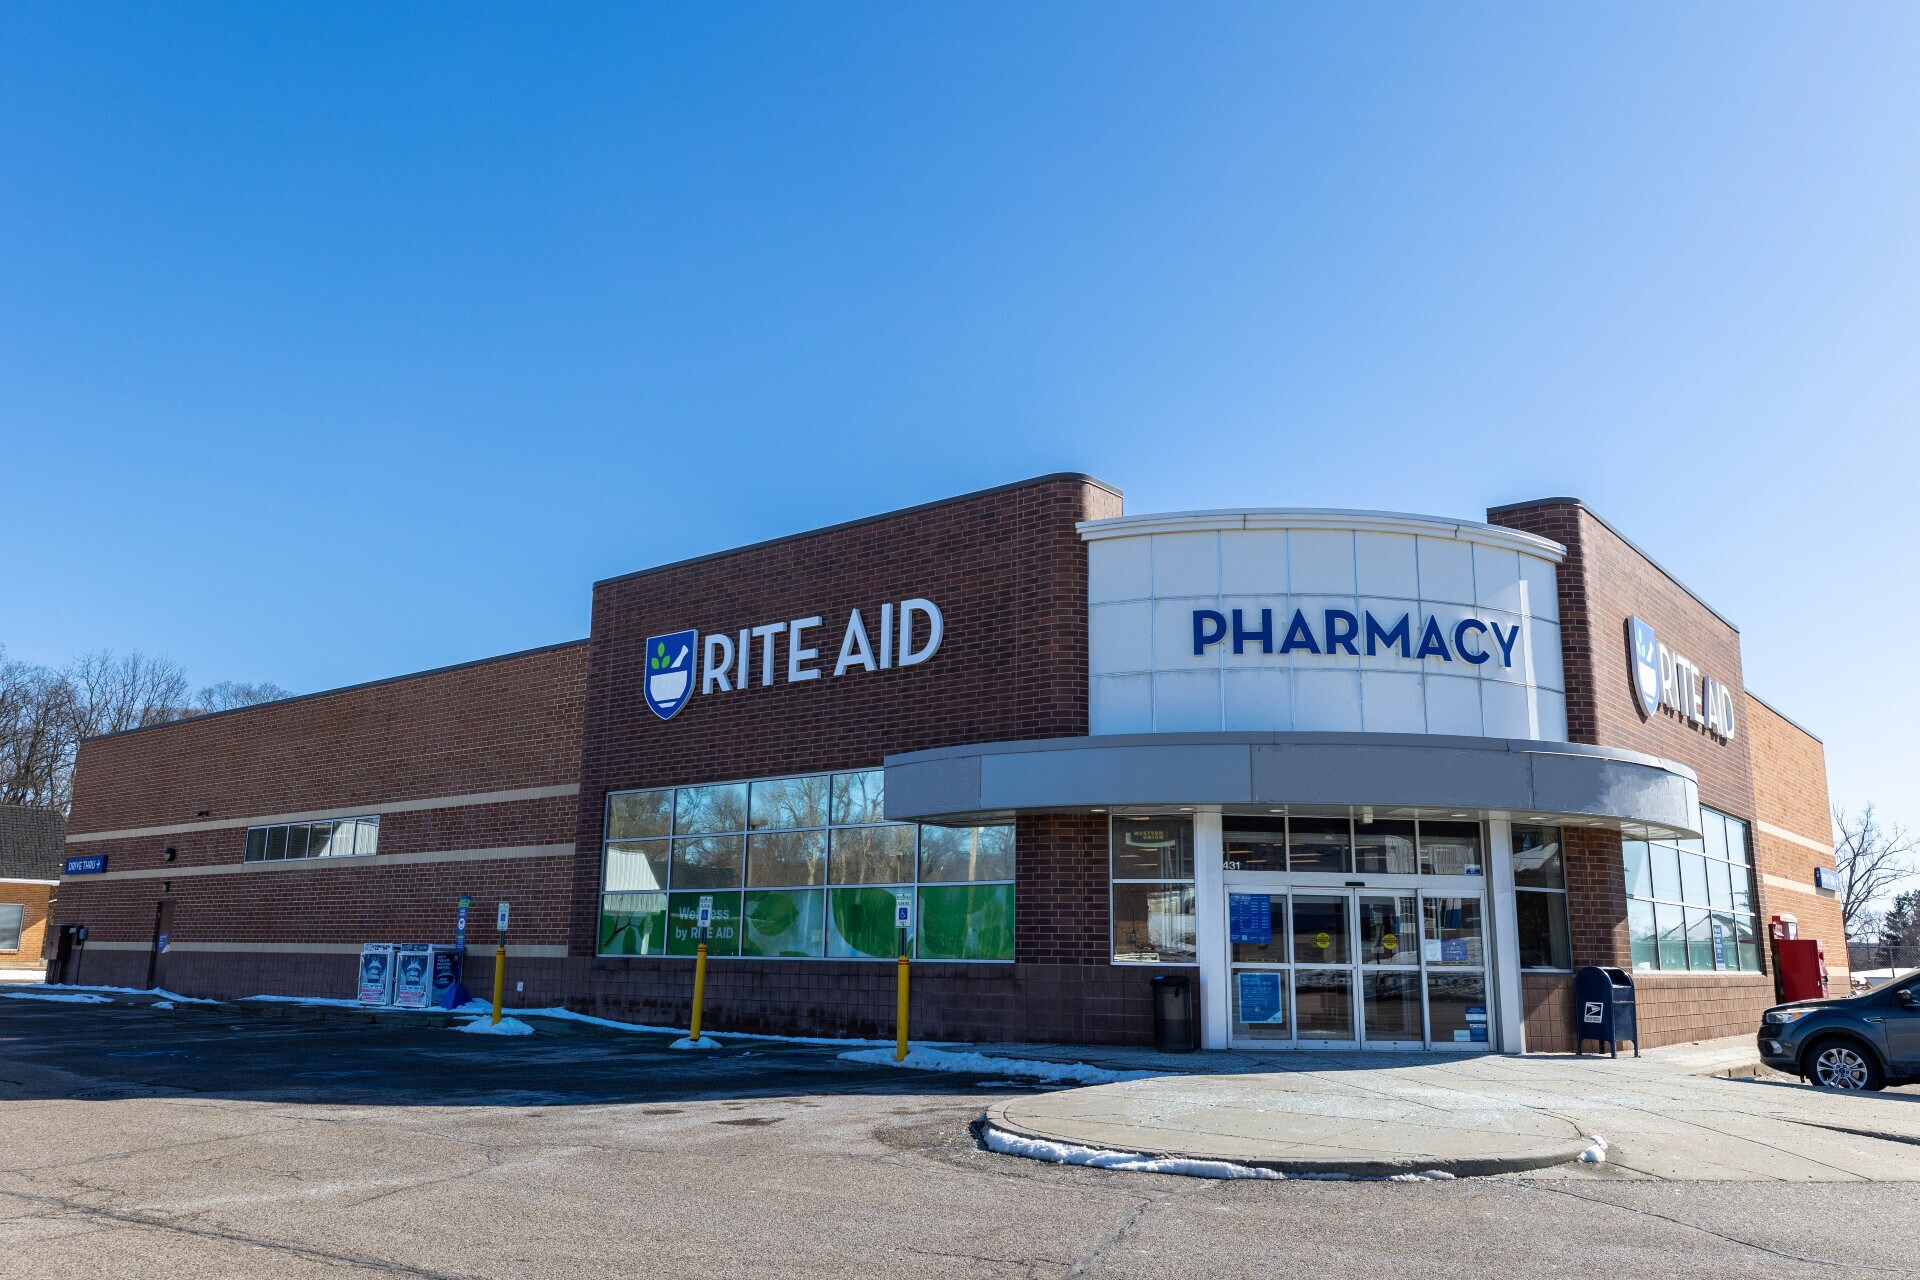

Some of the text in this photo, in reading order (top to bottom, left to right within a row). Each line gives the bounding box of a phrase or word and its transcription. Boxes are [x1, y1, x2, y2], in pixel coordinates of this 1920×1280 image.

[702, 598, 944, 695] RITE AID
[1192, 607, 1520, 670] PHARMACY
[1658, 641, 1735, 740] RITE AID
[68, 859, 96, 871] DRIVE THRU
[675, 926, 734, 941] by RIE AID
